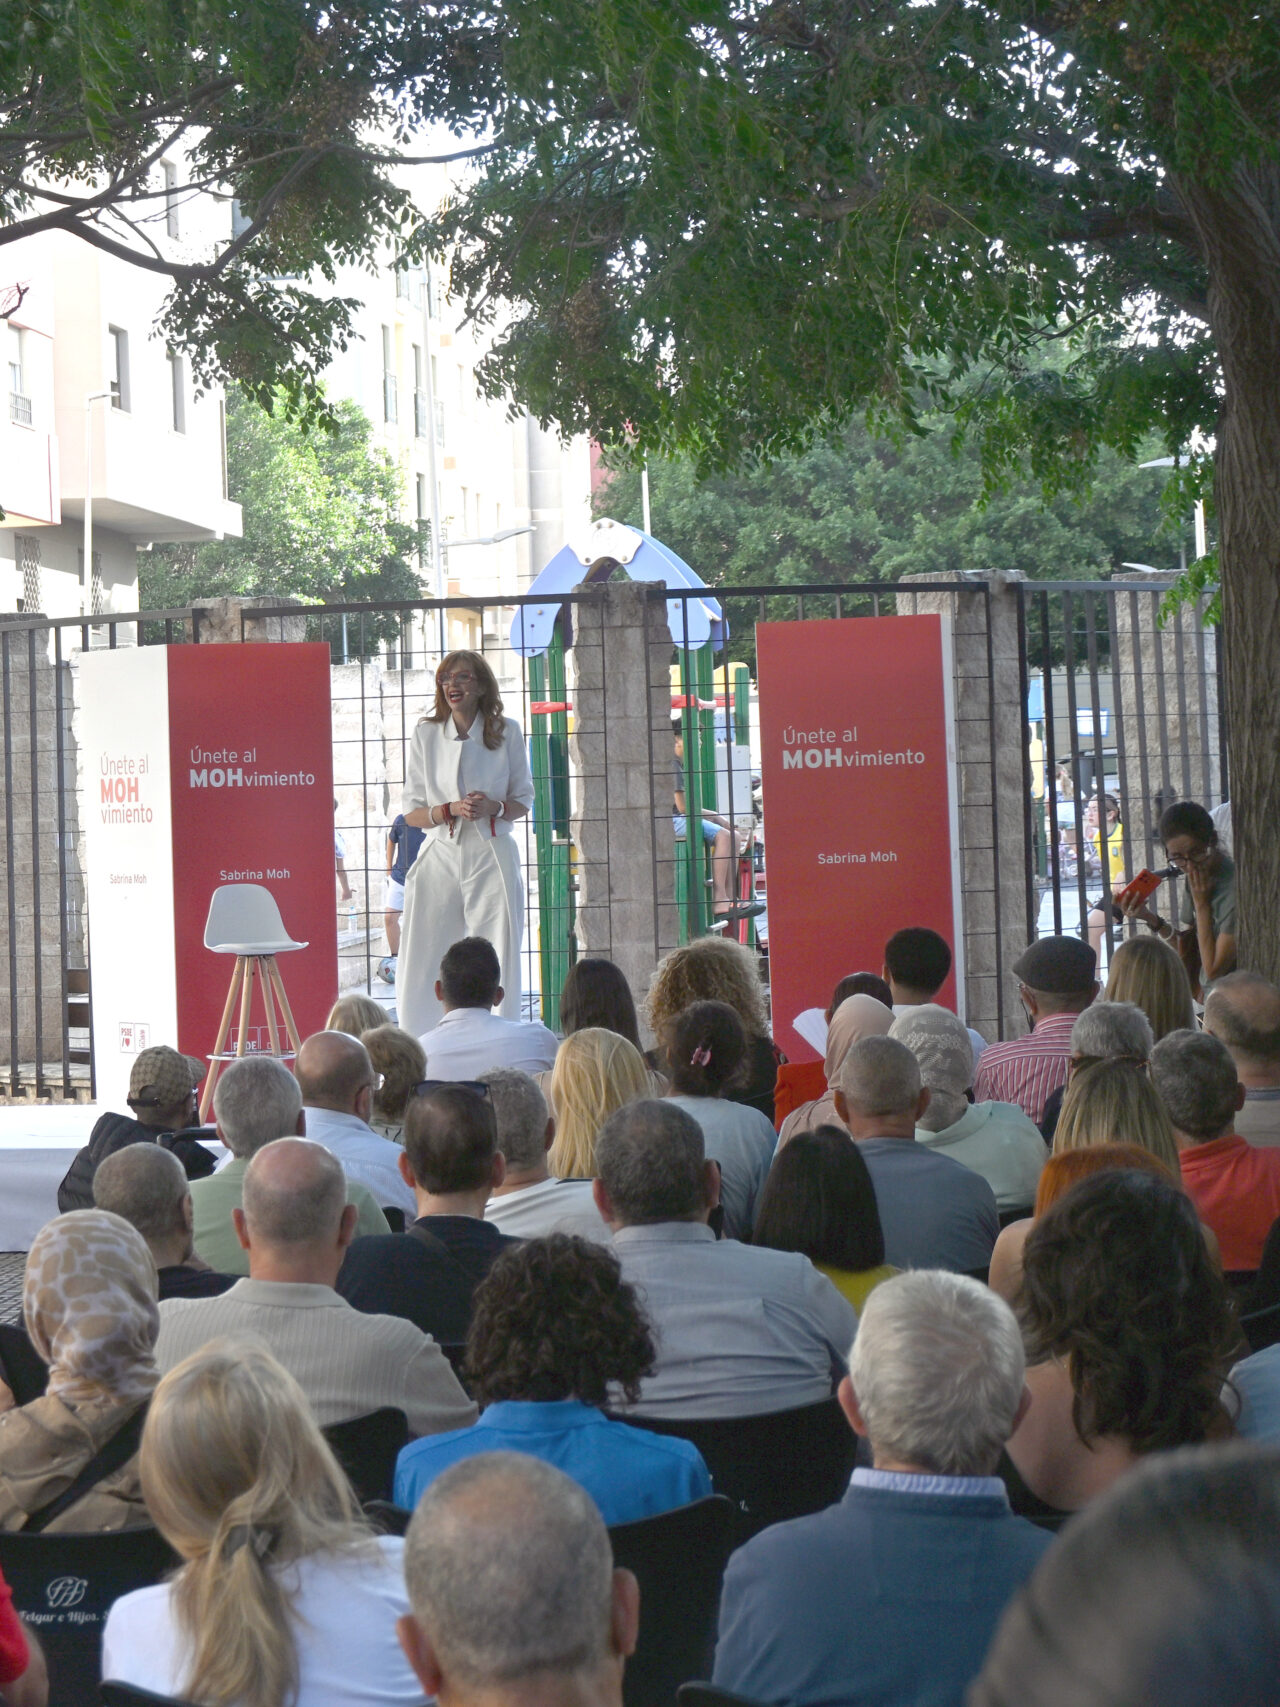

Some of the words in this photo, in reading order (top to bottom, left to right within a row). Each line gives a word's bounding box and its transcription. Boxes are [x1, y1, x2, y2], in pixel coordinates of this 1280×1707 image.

[783, 726, 836, 745] Únete
[842, 726, 858, 743] al
[100, 751, 135, 776] Únete
[138, 753, 149, 775] al
[190, 745, 238, 764] Únete
[243, 747, 257, 763] al
[782, 747, 925, 770] MOHvimiento
[189, 767, 315, 788] MOHvimiento
[100, 777, 139, 803] MOH
[101, 803, 153, 824] vimiento
[817, 852, 866, 865] Sabrina
[870, 851, 898, 863] Moh
[110, 873, 132, 884] Sabrina
[133, 873, 148, 884] Moh
[220, 869, 263, 881] Sabrina
[266, 868, 291, 880] Moh
